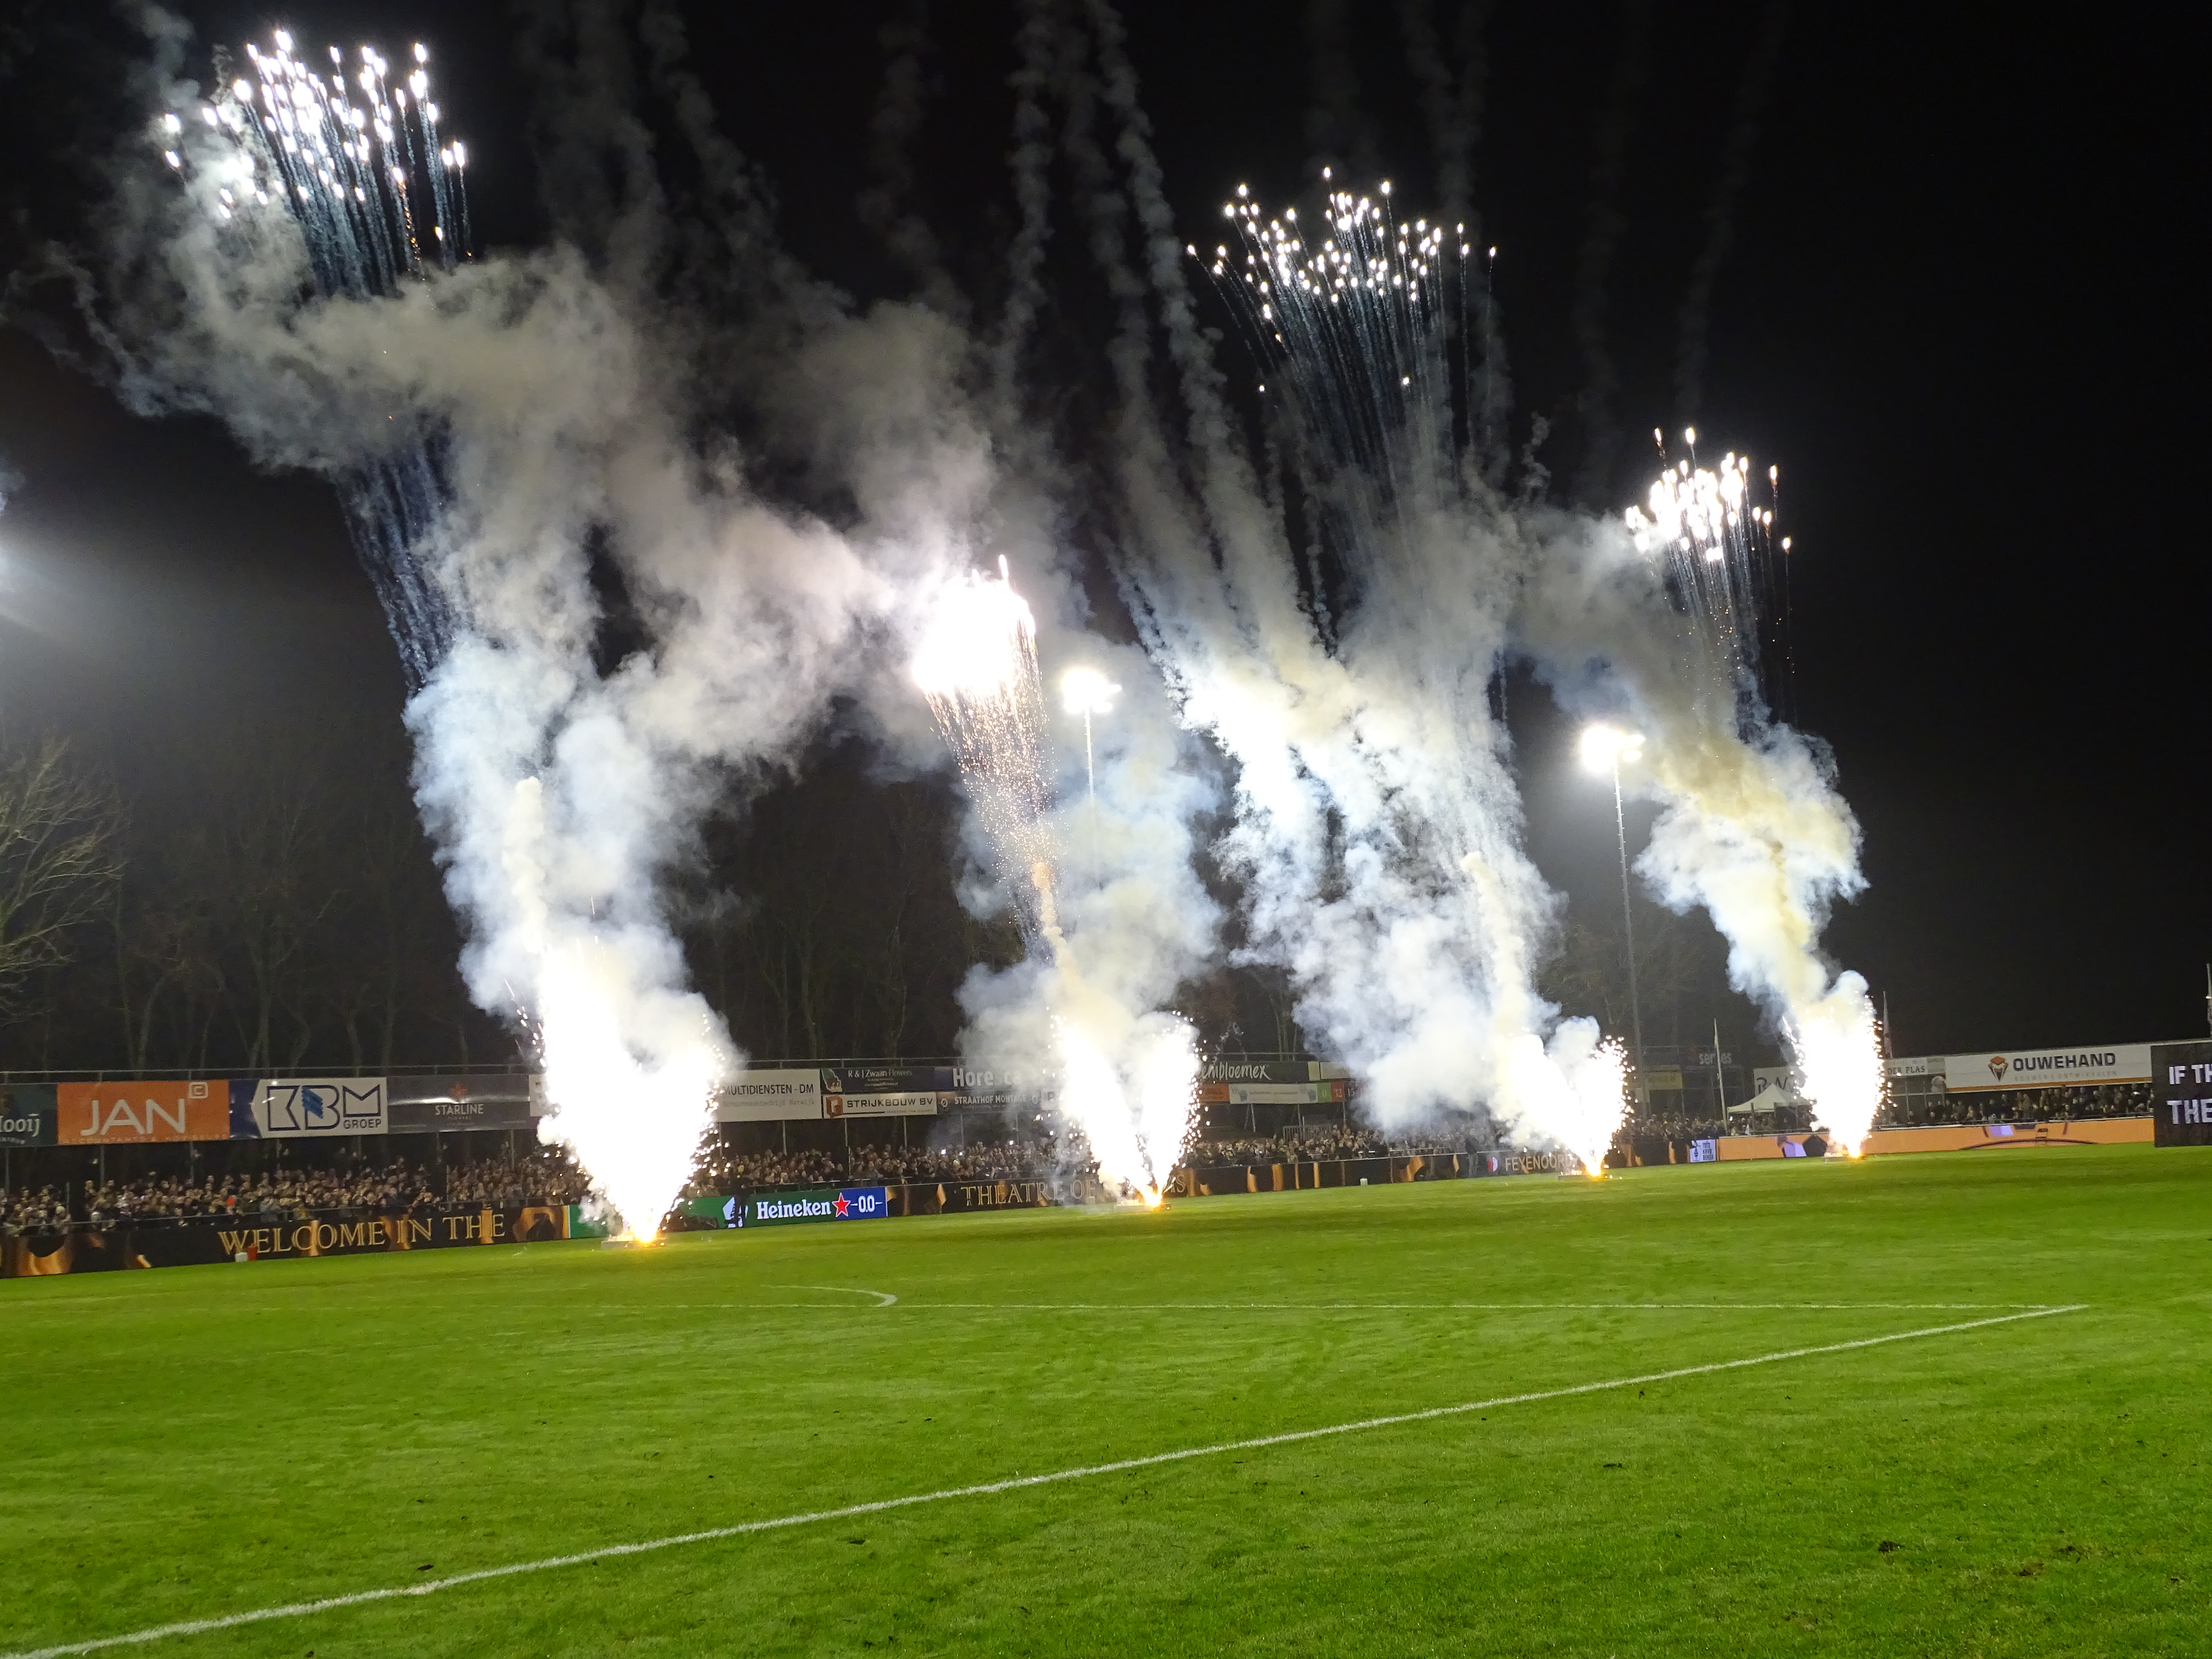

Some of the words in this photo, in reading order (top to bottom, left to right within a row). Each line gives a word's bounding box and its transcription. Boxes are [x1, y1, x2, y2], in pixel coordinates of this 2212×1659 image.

[1906, 1065, 1925, 1074] PLAS
[2013, 1053, 2116, 1071] OUWEHAND
[865, 1070, 887, 1079] Zwaan
[2169, 1066, 2186, 1085] IF
[723, 1084, 792, 1095] MULTIDIENSTEN
[799, 1084, 814, 1093] DM
[266, 1084, 381, 1131] KBM
[847, 1099, 916, 1108] STRIJKBOUW
[955, 1095, 993, 1104] STRAATHOF
[80, 1098, 186, 1136] JAN
[435, 1104, 484, 1115] STARLINE
[2167, 1099, 2212, 1124] THE
[0, 1113, 40, 1137] ooij
[343, 1118, 381, 1129] GROEP
[961, 1181, 1065, 1206] THEATRE
[757, 1199, 831, 1220] Heineken
[217, 1221, 385, 1255] WELCOME
[396, 1218, 432, 1243] IN
[442, 1213, 505, 1240] THE
